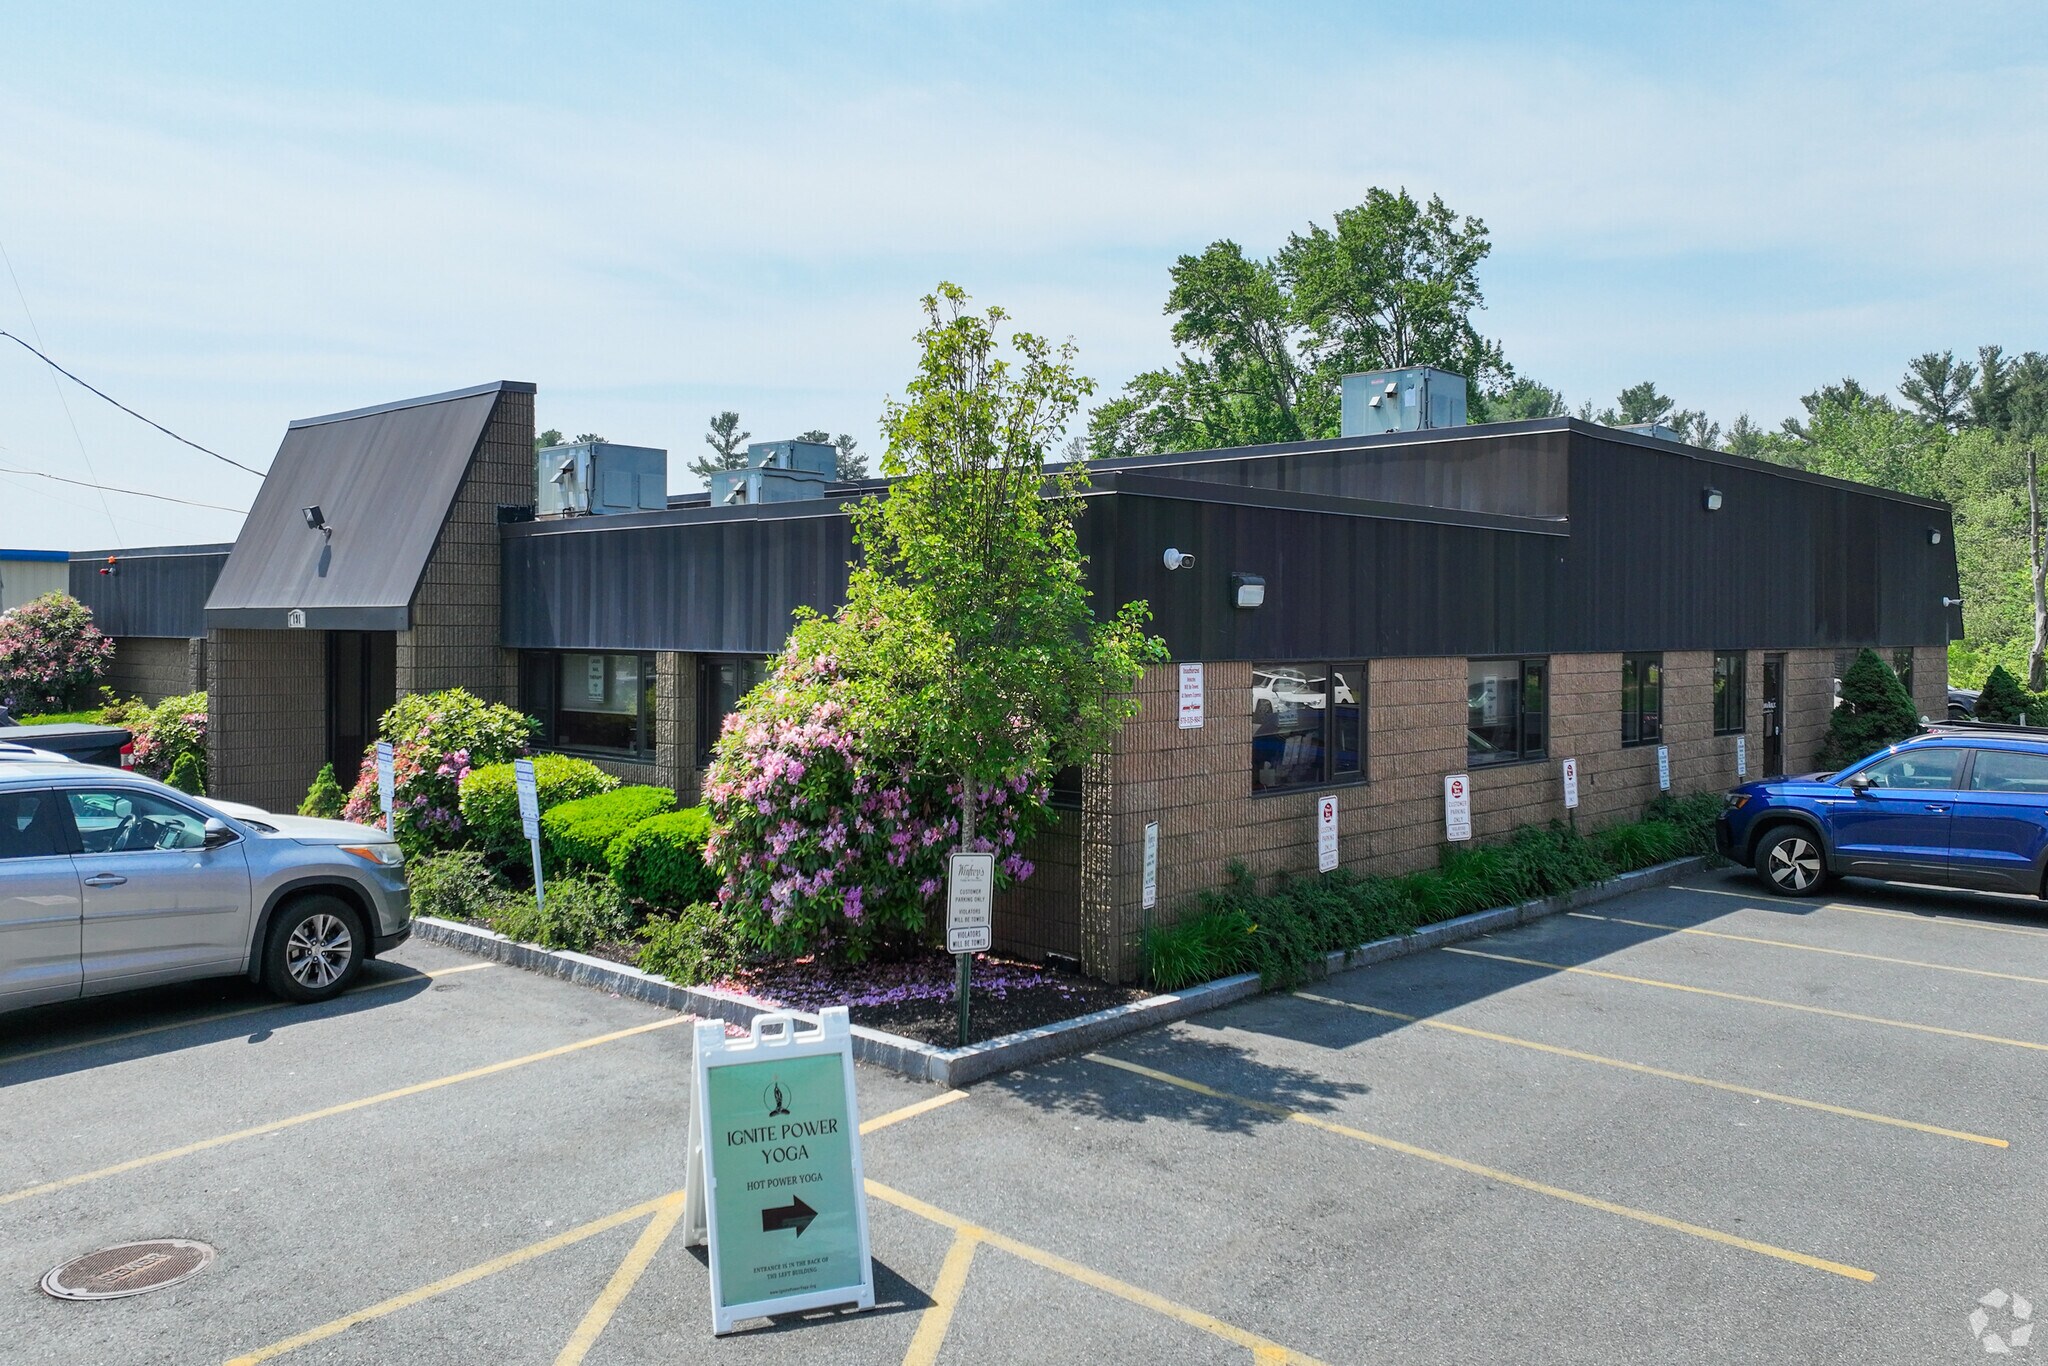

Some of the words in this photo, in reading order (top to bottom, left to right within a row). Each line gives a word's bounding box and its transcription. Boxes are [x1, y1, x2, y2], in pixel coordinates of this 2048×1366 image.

[957, 930, 981, 939] VIOLATORS
[953, 940, 964, 948] WILL
[971, 939, 986, 947] TOWED
[727, 1125, 778, 1147] IGNITE
[781, 1118, 838, 1140] POWER
[761, 1144, 809, 1164] YOGA
[746, 1180, 766, 1191] HOT
[767, 1177, 798, 1188] POWER
[799, 1172, 823, 1184] YOGA
[753, 1264, 781, 1274] ENTRANCE
[807, 1257, 821, 1266] BACK
[767, 1272, 777, 1280] THE
[778, 1270, 792, 1278] LEFT
[792, 1266, 818, 1277] BUILDING
